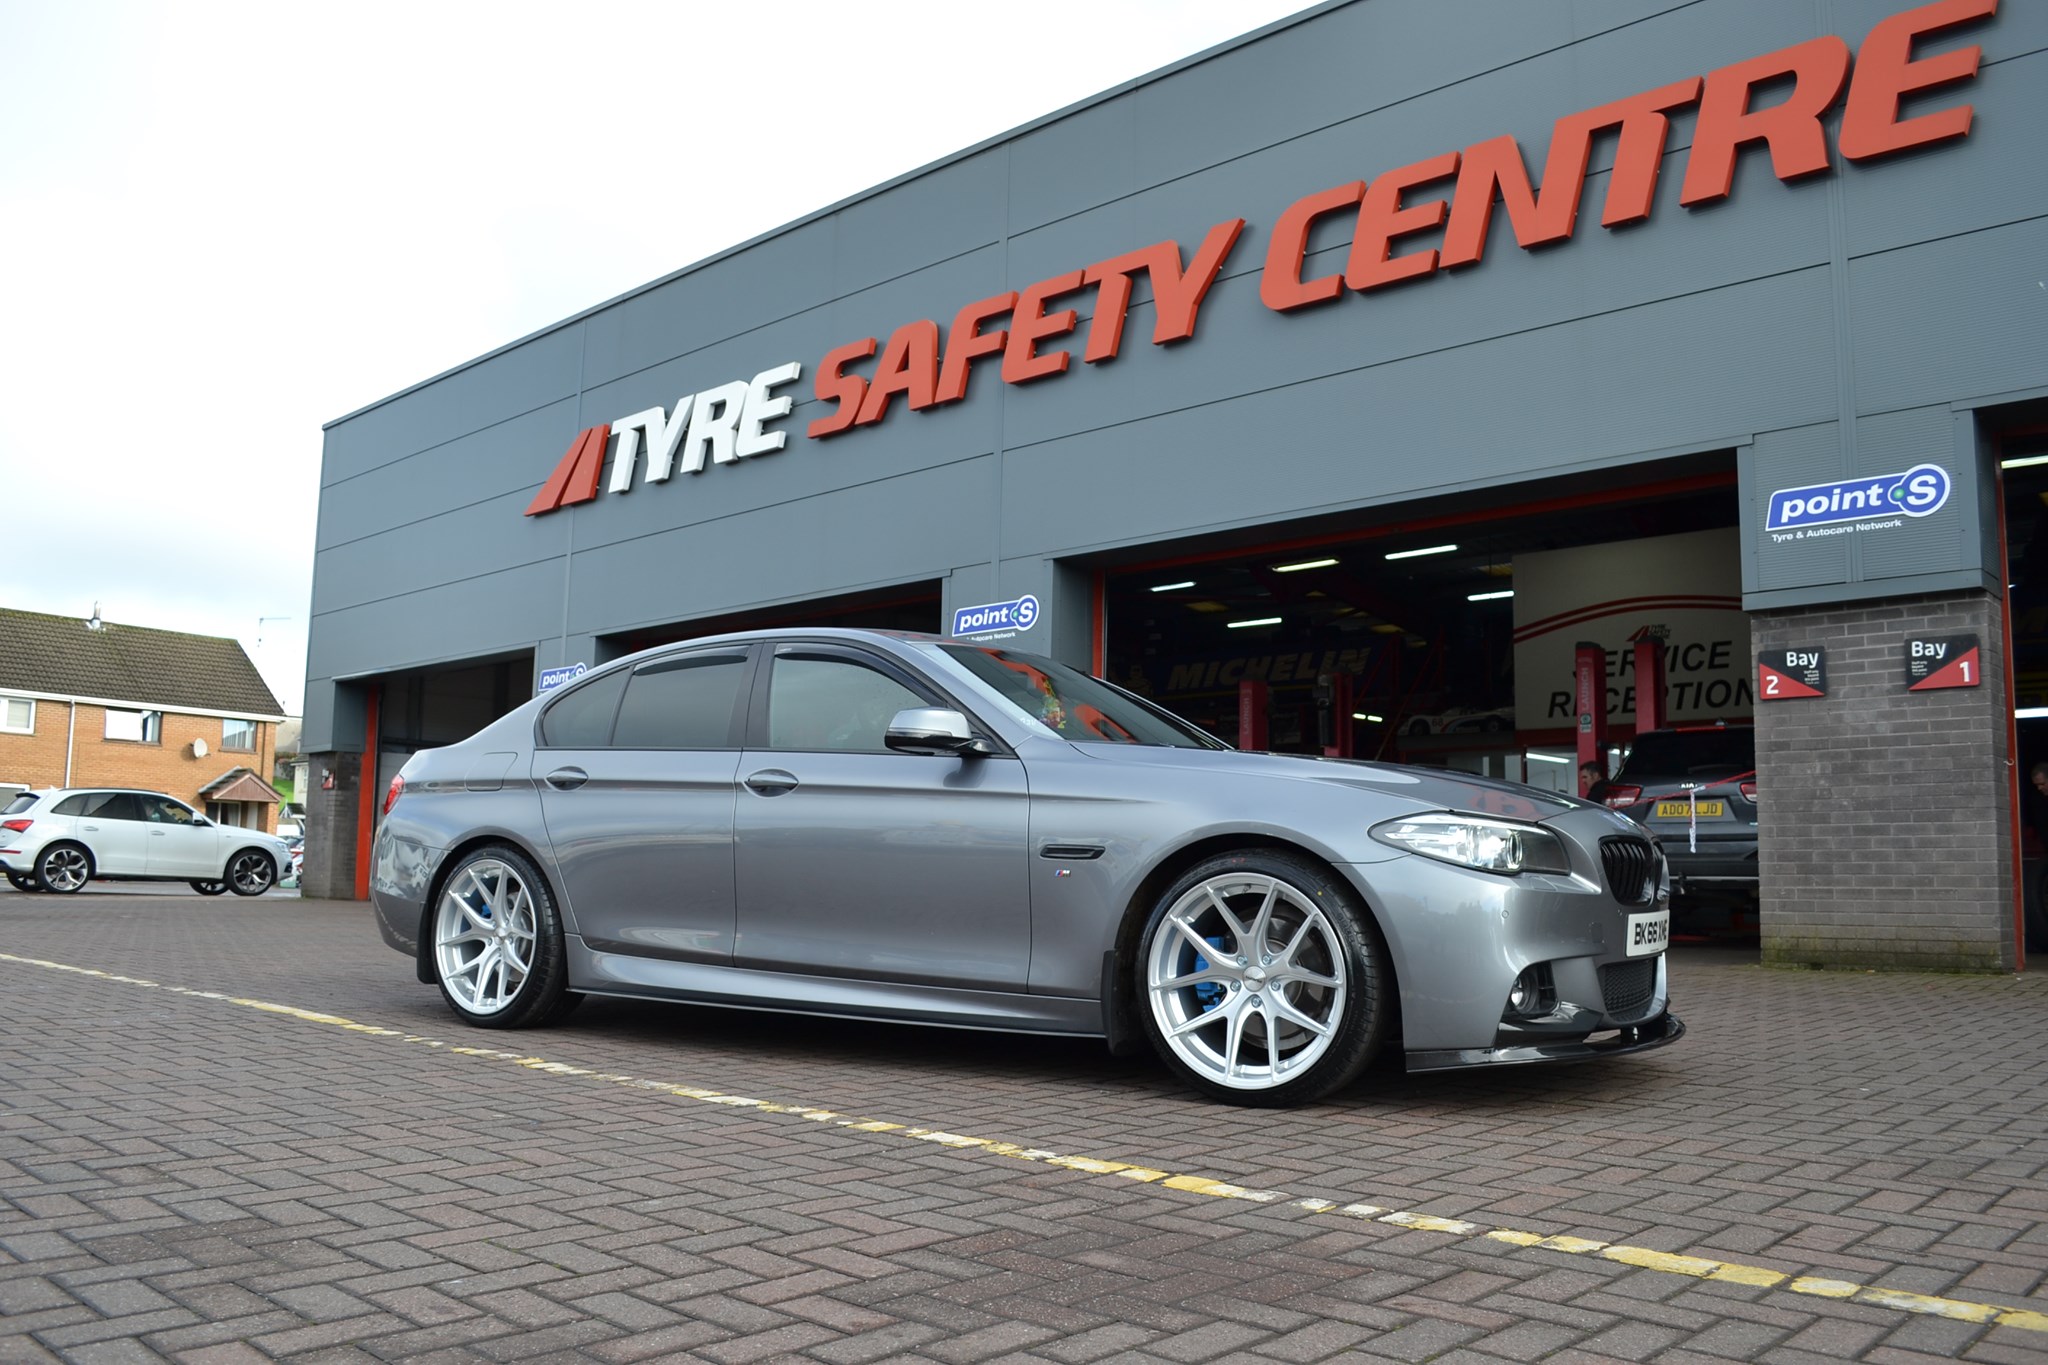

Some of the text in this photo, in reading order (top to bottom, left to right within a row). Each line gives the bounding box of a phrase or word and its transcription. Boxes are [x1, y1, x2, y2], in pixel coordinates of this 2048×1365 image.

[608, 0, 1998, 494] TYRE SAFETY CENTRE
[1780, 474, 1937, 523] point S
[1771, 519, 1903, 543] Tyre & Autocare Network
[959, 601, 1034, 632] point S
[1786, 651, 1819, 669] Bay
[1910, 641, 1946, 659] Bay
[542, 670, 570, 688] point
[1167, 647, 1372, 690] MICHELIN
[1959, 661, 1970, 682] 1
[1766, 675, 1779, 695] 2
